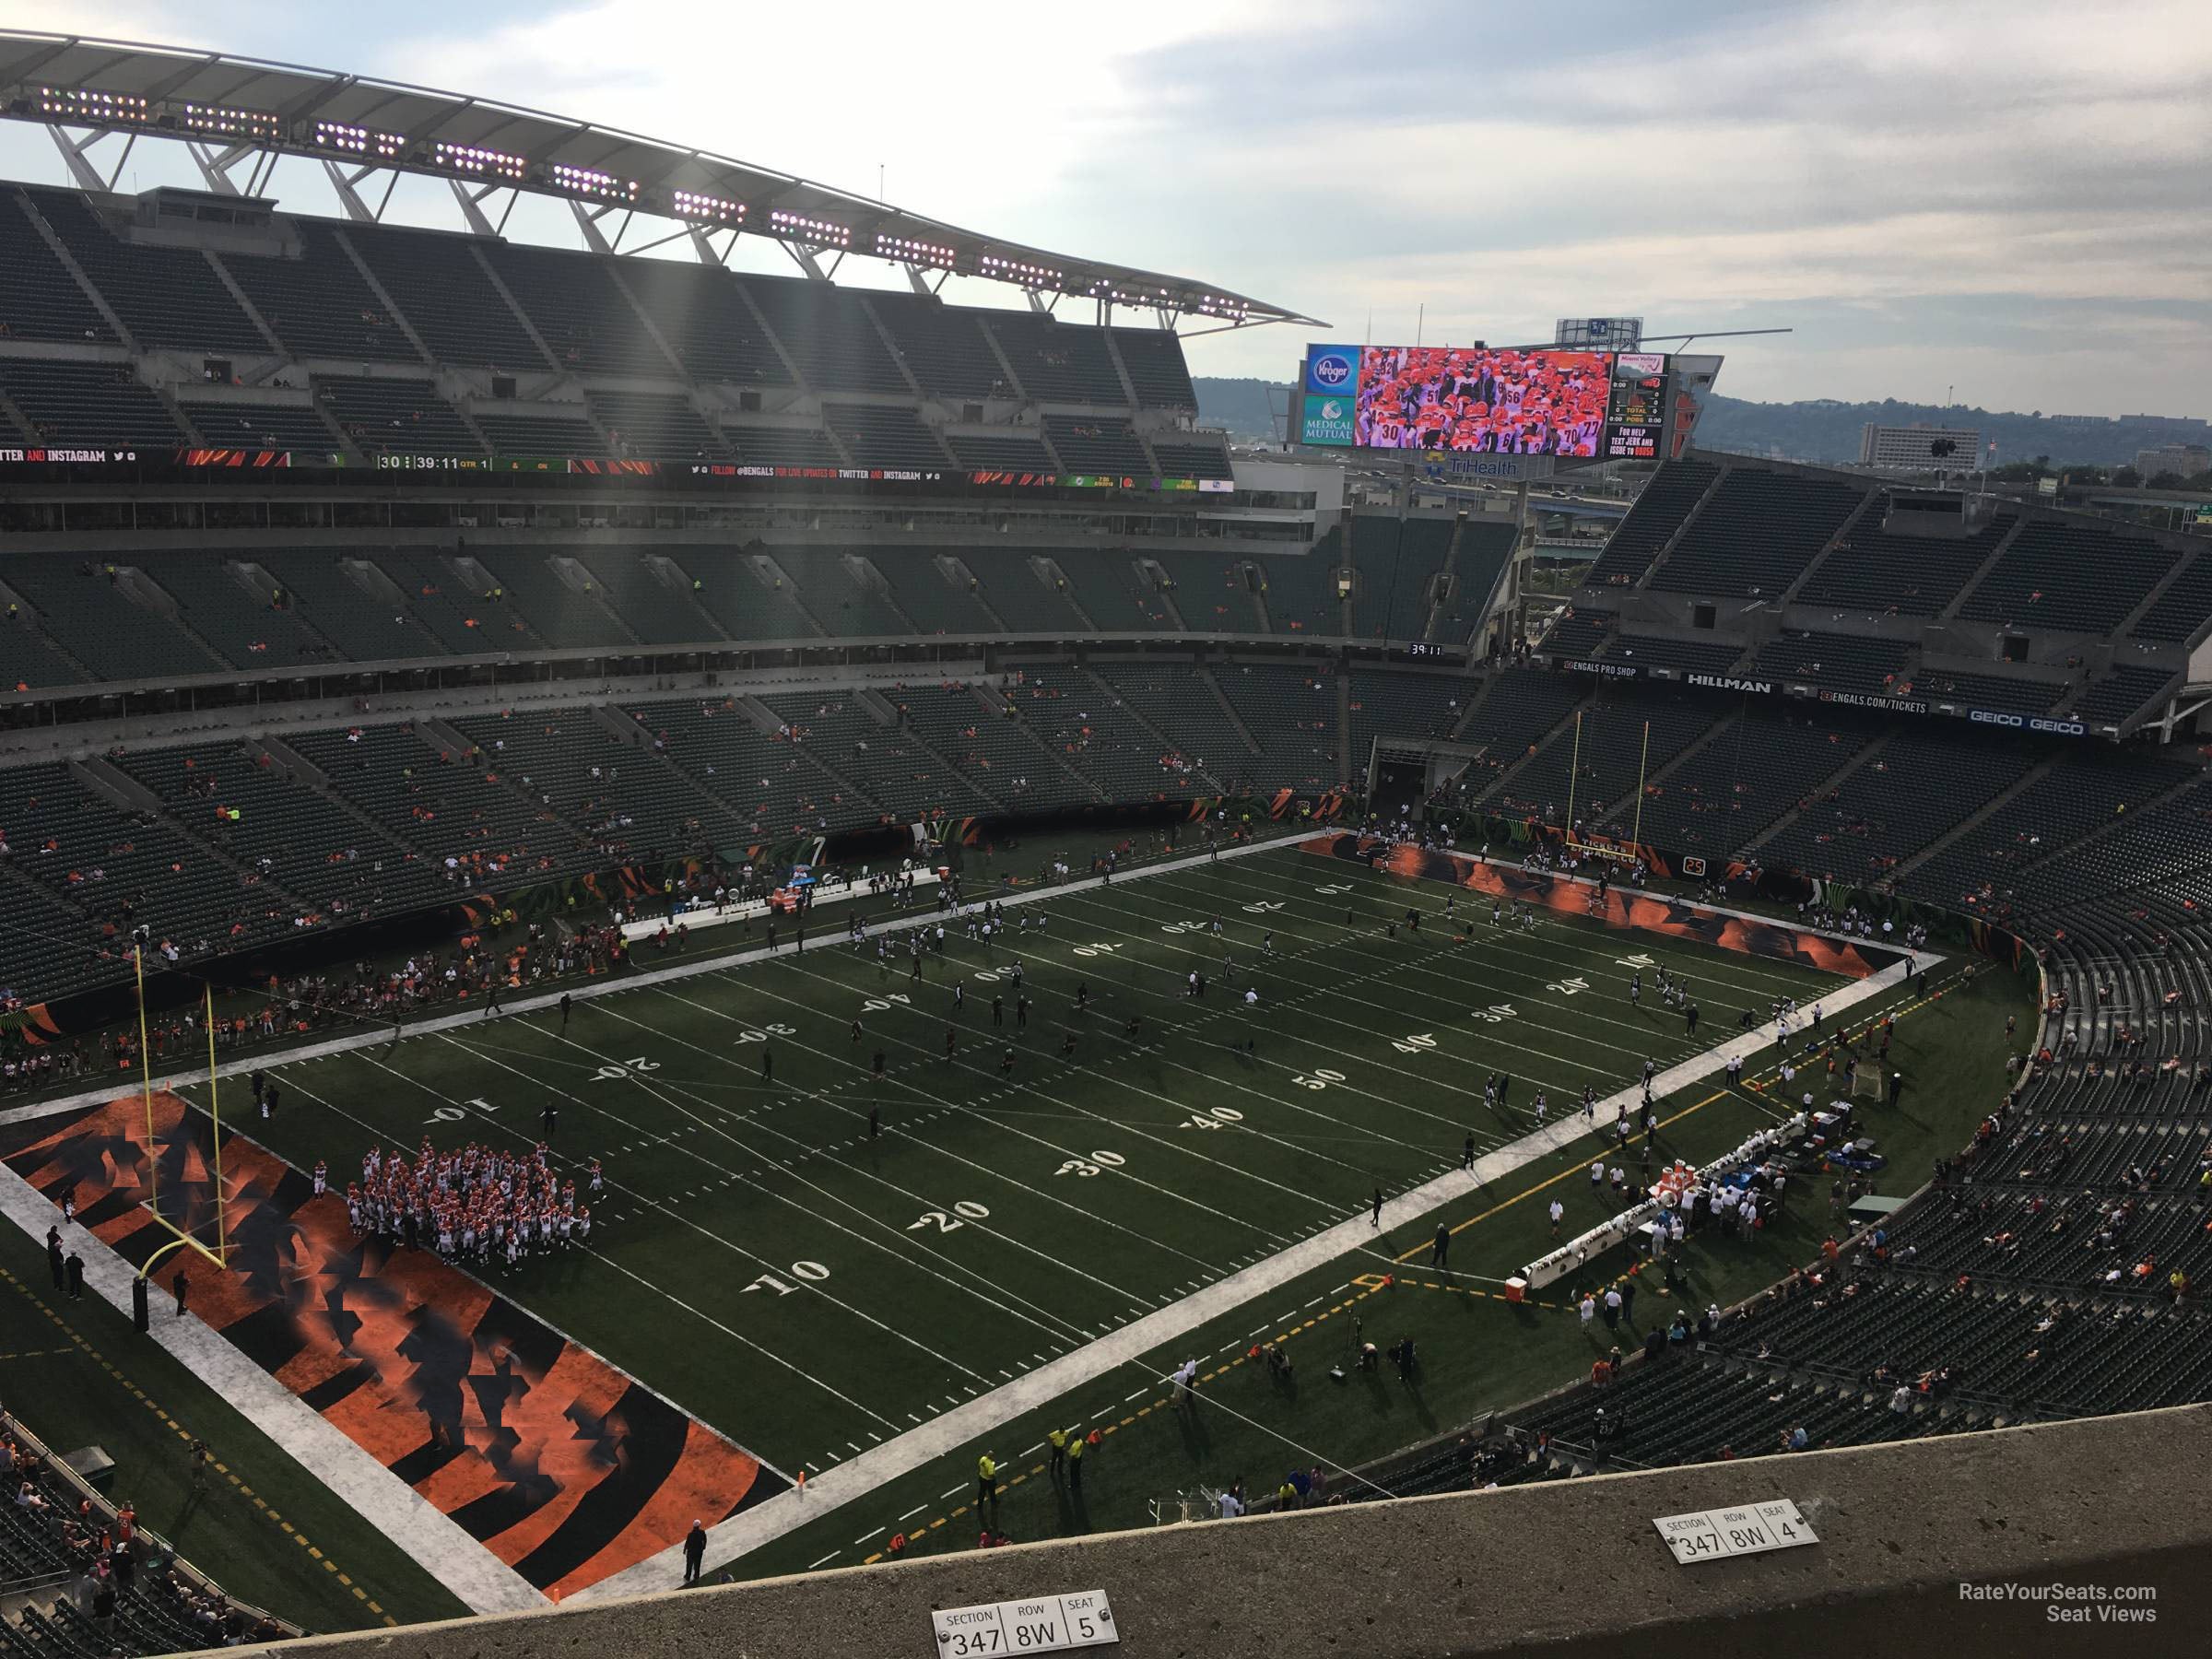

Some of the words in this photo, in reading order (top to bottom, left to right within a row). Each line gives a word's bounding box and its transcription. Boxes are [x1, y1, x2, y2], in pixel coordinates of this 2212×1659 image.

[1319, 359, 1347, 382] Kroger
[1507, 391, 1521, 404] 56
[1307, 420, 1352, 430] MEDICAL
[1382, 425, 1398, 441] 30
[1631, 428, 1646, 437] HELP
[1306, 429, 1351, 440] MUTUAL
[1611, 437, 1626, 445] TEXT
[1626, 437, 1641, 446] JERK
[1641, 439, 1653, 447] AND
[27, 450, 45, 461] AND
[48, 450, 106, 462] INSTAGRAM
[381, 456, 400, 468] 30
[417, 456, 458, 469] 39:11
[712, 465, 735, 475] FOLLOW
[737, 466, 774, 477] @BENGALS
[839, 469, 869, 479] TWITTER
[883, 471, 921, 480] INSTAGRAM
[1450, 457, 1517, 476] TriHealth
[1412, 644, 1441, 655] 39:11
[1601, 665, 1616, 675] PRO
[1617, 666, 1637, 677] SHOP
[1688, 674, 1771, 693] HILLMAN
[1971, 711, 2022, 726] GEICO
[2030, 719, 2083, 735] GEICO
[1583, 839, 1627, 853] TICKETS
[1687, 859, 1702, 874] 25
[1616, 954, 1655, 971] 10
[1547, 977, 1590, 994] 20
[864, 994, 912, 1011] 40
[1471, 1005, 1518, 1022] 30
[739, 1023, 796, 1043] 30
[1392, 1034, 1438, 1054] 40
[597, 1056, 661, 1079] 20
[1291, 1068, 1347, 1090] 50
[433, 1097, 500, 1122] 10
[1192, 1107, 1244, 1130] 40
[1065, 1150, 1125, 1177] 30
[920, 1201, 990, 1232] 20
[758, 1260, 830, 1297] 10
[1666, 1519, 1706, 1532] SECTION
[1724, 1512, 1747, 1524] ROW
[1763, 1505, 1786, 1517] SEAT
[1679, 1534, 1721, 1556] 347
[1730, 1526, 1766, 1548] 8W
[1783, 1522, 1797, 1540] 4
[947, 1610, 993, 1626] SECTION
[1018, 1604, 1044, 1617] ROW
[1067, 1597, 1094, 1610] SEAT
[952, 1629, 999, 1655] 347
[1017, 1621, 1054, 1647] 8W
[1079, 1617, 1095, 1638] 5
